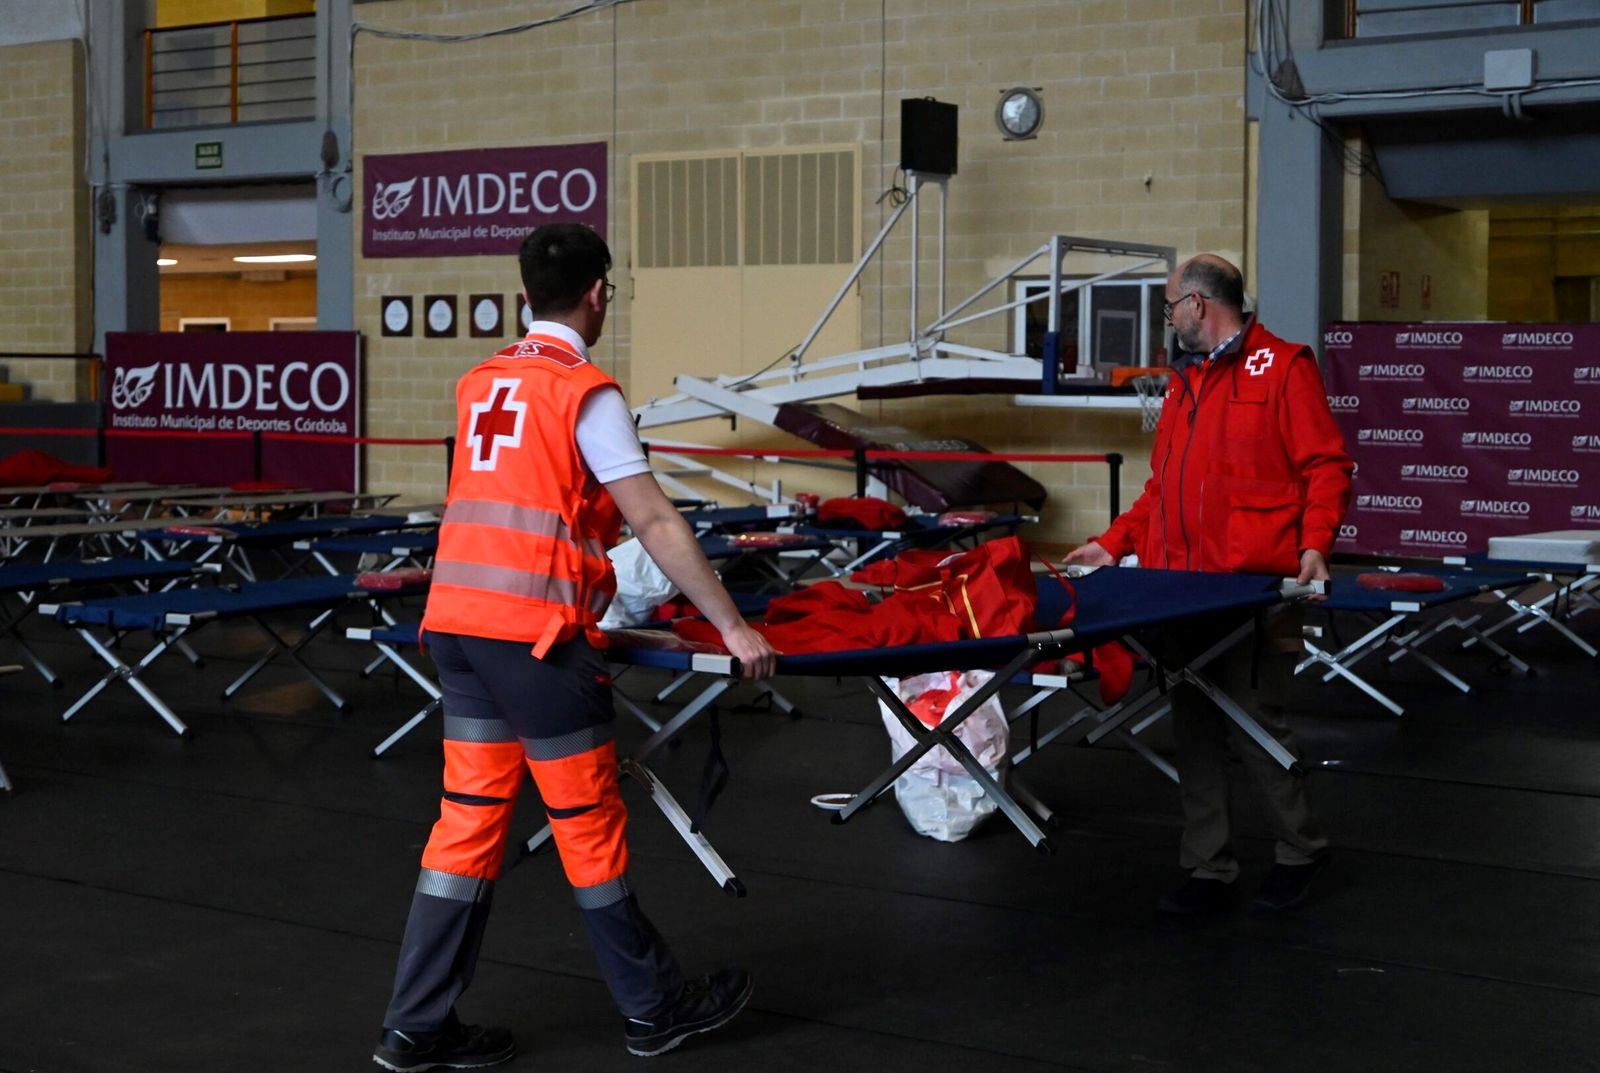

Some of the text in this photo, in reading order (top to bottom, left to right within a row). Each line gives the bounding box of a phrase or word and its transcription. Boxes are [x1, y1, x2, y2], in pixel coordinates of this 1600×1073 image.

[422, 168, 597, 217] IMDECO
[372, 225, 535, 242] Instituto Municipal de Deport
[1411, 332, 1462, 344] IMDECO
[1519, 333, 1573, 344] IMDECO
[1374, 365, 1424, 376] IMDECO
[1479, 366, 1532, 377] IMDECO
[164, 361, 350, 412] IMDECO
[1327, 396, 1360, 408] DECO
[1418, 398, 1469, 409] IMDECO
[1526, 400, 1580, 412] IMDECO
[112, 413, 347, 433] Instituto Municipal de Deportes Córdoba
[1373, 429, 1423, 441] IMDECO
[1478, 432, 1531, 444] IMDECO
[1416, 465, 1468, 478] IMDECO
[1524, 470, 1579, 482] IMDECO
[1372, 496, 1422, 508] IMDECO
[1476, 501, 1530, 514] IMDECO
[1416, 530, 1467, 543] IMDECO
